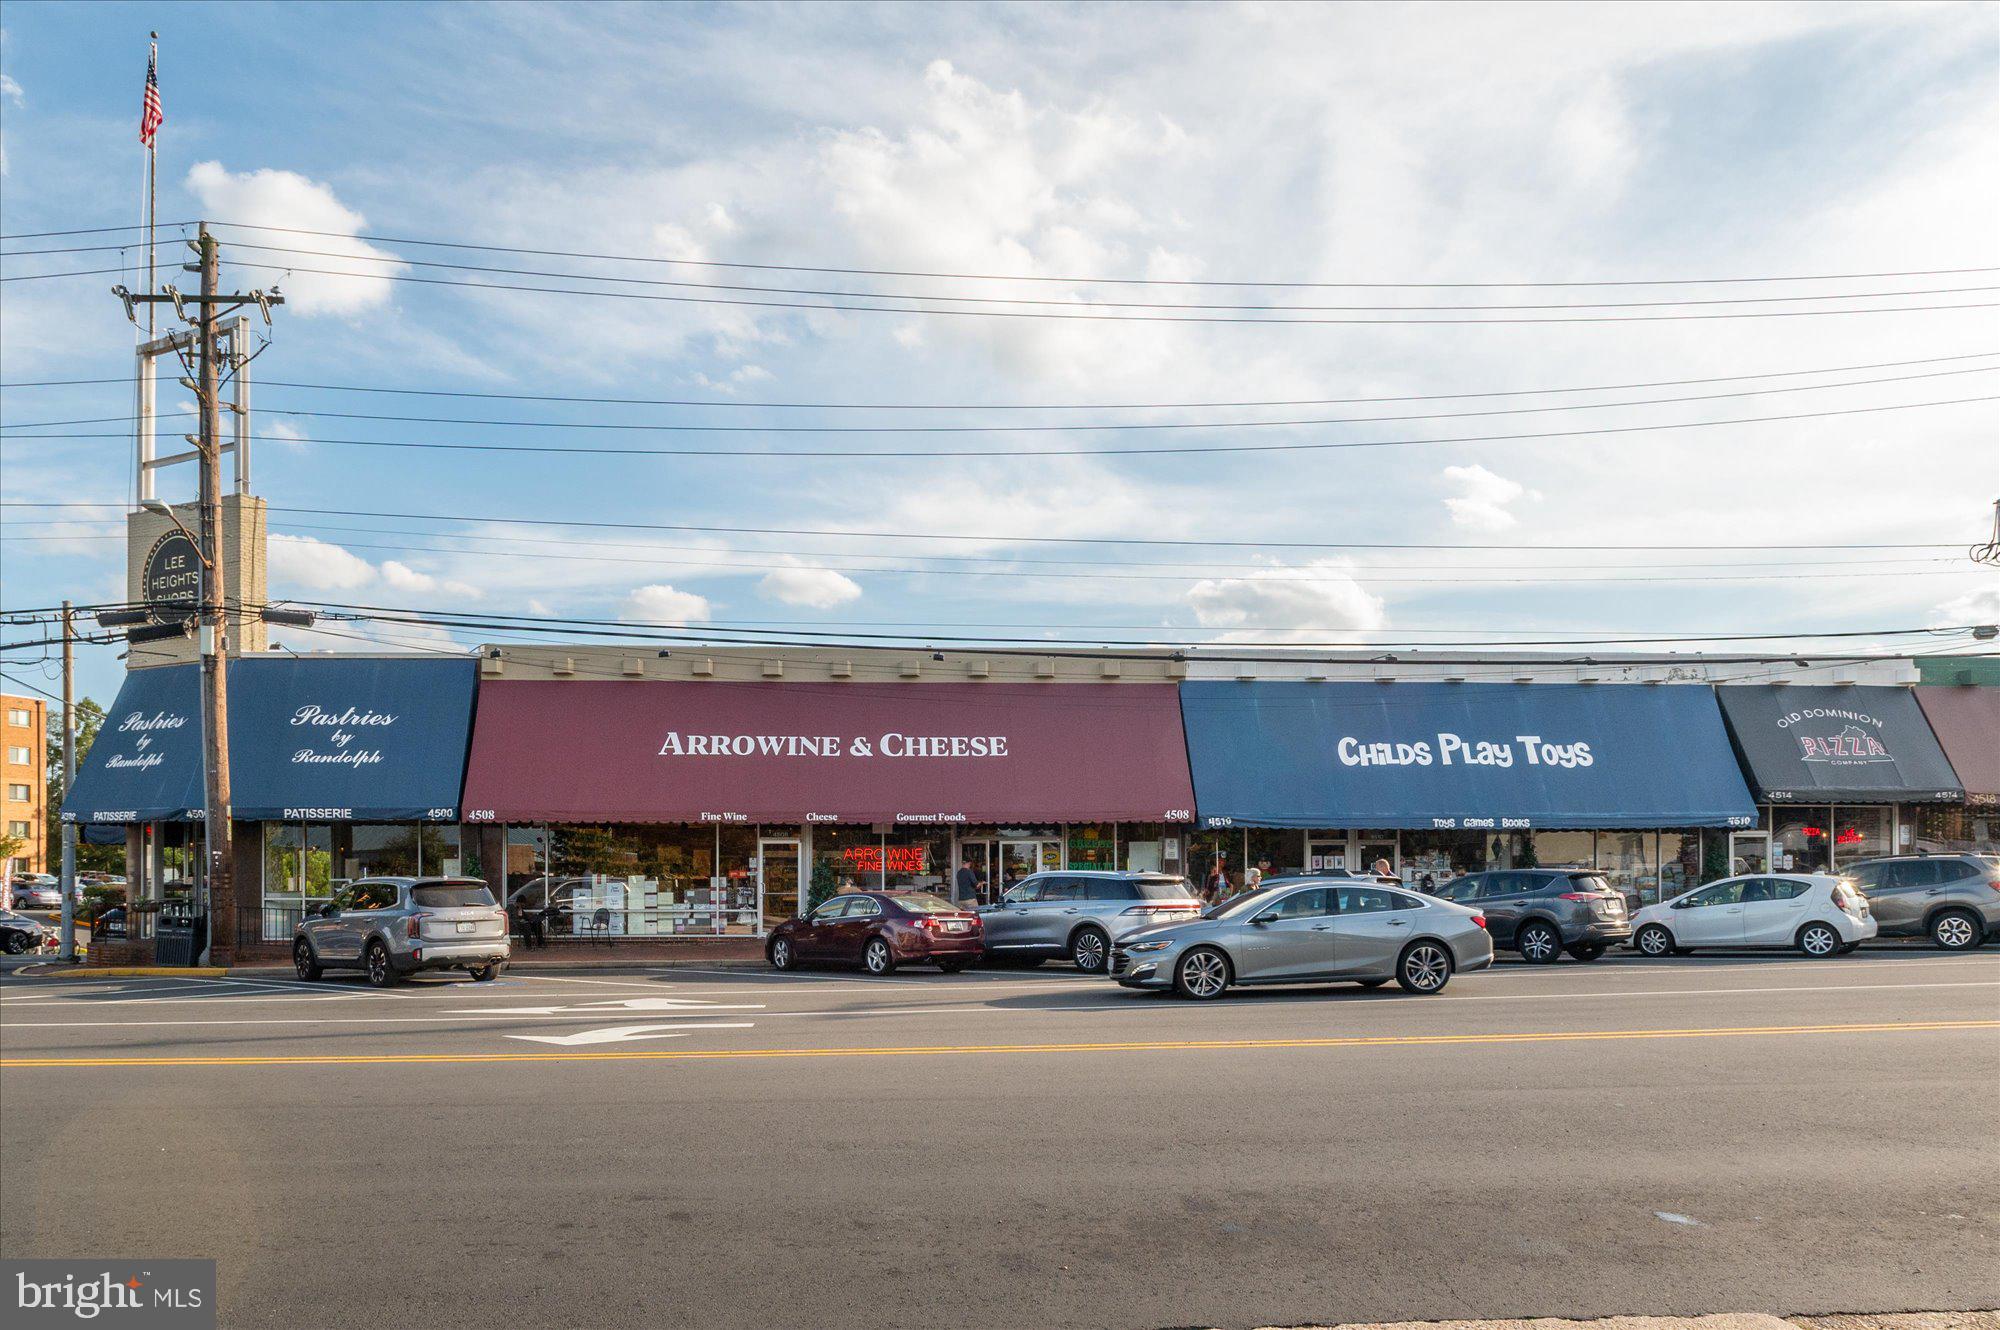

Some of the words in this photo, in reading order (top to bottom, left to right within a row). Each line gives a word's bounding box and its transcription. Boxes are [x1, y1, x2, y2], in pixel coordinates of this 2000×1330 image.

[164, 555, 186, 570] LEE
[151, 571, 199, 590] HEIGHTS
[290, 704, 399, 726] Pastries
[1777, 712, 1801, 728] OLD
[1803, 708, 1883, 728] DOMINION
[118, 711, 189, 731] Pastries
[136, 734, 152, 751] by
[330, 729, 355, 748] by
[658, 731, 841, 757] ARROWINE
[849, 736, 873, 757] &
[880, 733, 1008, 757] CHEESE
[1800, 736, 1886, 756] PIZZA
[105, 752, 164, 771] Randolph
[291, 749, 384, 768] Randolph
[1935, 791, 1958, 799] 4514
[1972, 794, 1996, 804] 4518
[94, 811, 137, 821] PATISSERIE
[186, 809, 206, 819] 450
[284, 808, 352, 819] PATISSERIE
[427, 808, 453, 818] 4500
[469, 810, 495, 820] 4508
[701, 812, 721, 820] Fine
[723, 812, 748, 821] Wine
[806, 812, 838, 821] Cheese
[896, 813, 937, 822] Gourmet
[938, 813, 966, 821] Foods
[1164, 810, 1190, 820] 4508
[1208, 817, 1232, 827] 4510
[1727, 816, 1751, 825] 4510
[857, 860, 883, 870] FINE
[885, 860, 924, 870] WINES
